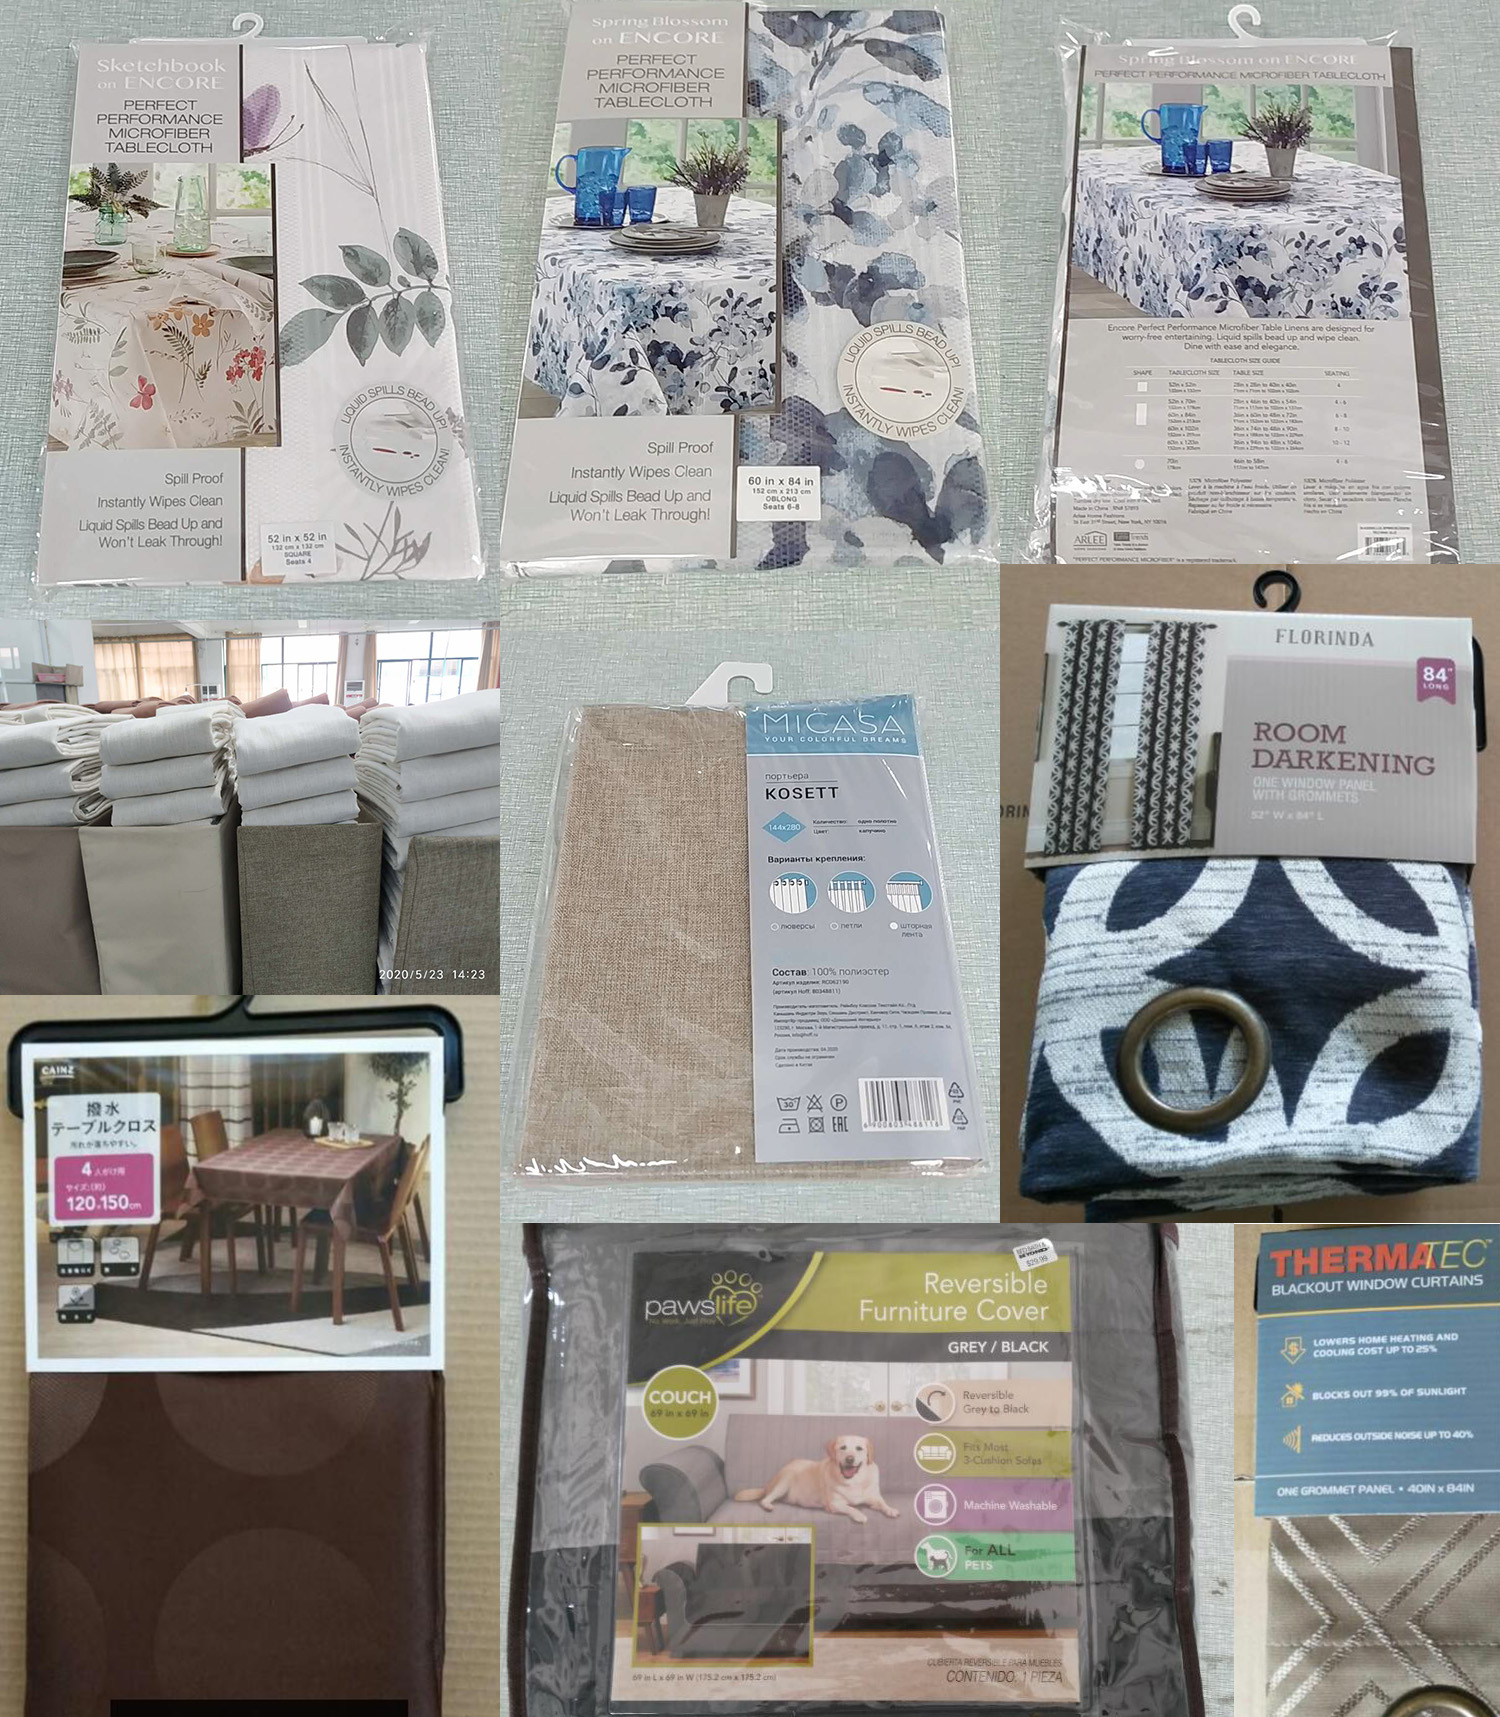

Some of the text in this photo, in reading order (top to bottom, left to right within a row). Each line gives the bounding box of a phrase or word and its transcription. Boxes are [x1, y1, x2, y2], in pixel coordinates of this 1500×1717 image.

[592, 15, 729, 29] Spring Blossom
[592, 31, 725, 45] on ENCORE
[97, 58, 226, 72] Sketchbook
[617, 54, 697, 65] PERFECT
[587, 68, 725, 80] PERFORMANCE
[97, 76, 224, 89] on ENCORE
[599, 82, 710, 94] MICROFIBER
[124, 100, 197, 110] PERFECT
[594, 96, 713, 108] TABLECLOTH
[97, 114, 223, 125] PERFORMANCE
[109, 128, 211, 139] MICROFIBER
[105, 142, 213, 153] TABLECLOTH
[1107, 324, 1135, 332] Encore
[1137, 324, 1165, 332] Perfect
[1168, 323, 1217, 331] Performance
[1219, 324, 1259, 332] Microfiber
[1261, 324, 1282, 332] Table
[1284, 324, 1309, 332] Linens
[1325, 325, 1362, 334] designed
[1364, 325, 1375, 333] for
[1122, 333, 1162, 342] worry-free
[1164, 333, 1214, 342] entertaining.
[1216, 333, 1241, 342] Liquid
[1243, 334, 1263, 342] spills
[1287, 335, 1298, 343] up
[1317, 335, 1336, 343] wipe
[1261, 343, 1300, 352] elegance.
[647, 441, 714, 456] Spill Proof
[571, 465, 712, 480] Instantly Wipes Clean
[164, 473, 224, 486] Spill Proof
[748, 476, 762, 486] 60
[765, 476, 775, 485] in
[788, 477, 801, 486] 84
[804, 477, 814, 486] in
[97, 495, 223, 510] Instantly Wipes Clean
[79, 518, 223, 533] Liquid Spills Bead Up and
[99, 535, 223, 549] Won't Leak Through!
[268, 534, 280, 543] 52
[282, 534, 292, 542] in
[303, 533, 315, 541] 52
[318, 532, 327, 541] in
[1275, 628, 1375, 647] FLORINDA
[1423, 682, 1449, 690] LONG
[763, 713, 905, 735] MICASA
[1253, 722, 1347, 745] ROOM
[863, 736, 907, 744] DREAMS
[1251, 748, 1436, 776] DARKENING
[765, 773, 809, 781] портьера
[1253, 776, 1377, 792] ONE WINDOW PANEL
[765, 786, 839, 800] KOSETT
[1253, 789, 1359, 804] WITH GROMMETS
[767, 855, 866, 864] Варианты крепления:
[772, 967, 890, 977] Состав: 100% полиэстер
[41, 1065, 74, 1075] CAINZ
[87, 1101, 120, 1117] 撥水
[52, 1119, 157, 1137] テーブルクロス
[925, 1272, 1048, 1294] Reversible
[1272, 1275, 1484, 1296] BLACKOUT WINDOW CURTAINS
[645, 1295, 753, 1320] pawslife
[860, 1298, 1049, 1322] Furniture Cover
[1314, 1333, 1459, 1346] LOWERS HOME HEATING AND
[948, 1341, 1049, 1353] GREY / BLACK
[1313, 1345, 1437, 1358] COOLING COST UP TO 25%
[649, 1390, 712, 1404] COUCH
[963, 1391, 1014, 1400] Reversible
[1312, 1387, 1467, 1401] BLOCKS OUT 99% OF SUNLIGHT
[963, 1404, 1029, 1416] Grey to Black
[1311, 1430, 1474, 1442] REDUCES OUTSIDE NOISE UP TO 40%
[964, 1443, 1008, 1452] Fits Most
[964, 1456, 1042, 1465] 3-Cushion Sofas
[1277, 1486, 1299, 1497] ONE
[1300, 1485, 1355, 1496] GROMMET
[1358, 1484, 1395, 1494] PANEL
[1407, 1484, 1436, 1494] 40IN
[1446, 1483, 1475, 1493] 84IN
[964, 1501, 1058, 1511] Machine Washable
[965, 1544, 1015, 1556] For ALL
[964, 1560, 993, 1570] PETS
